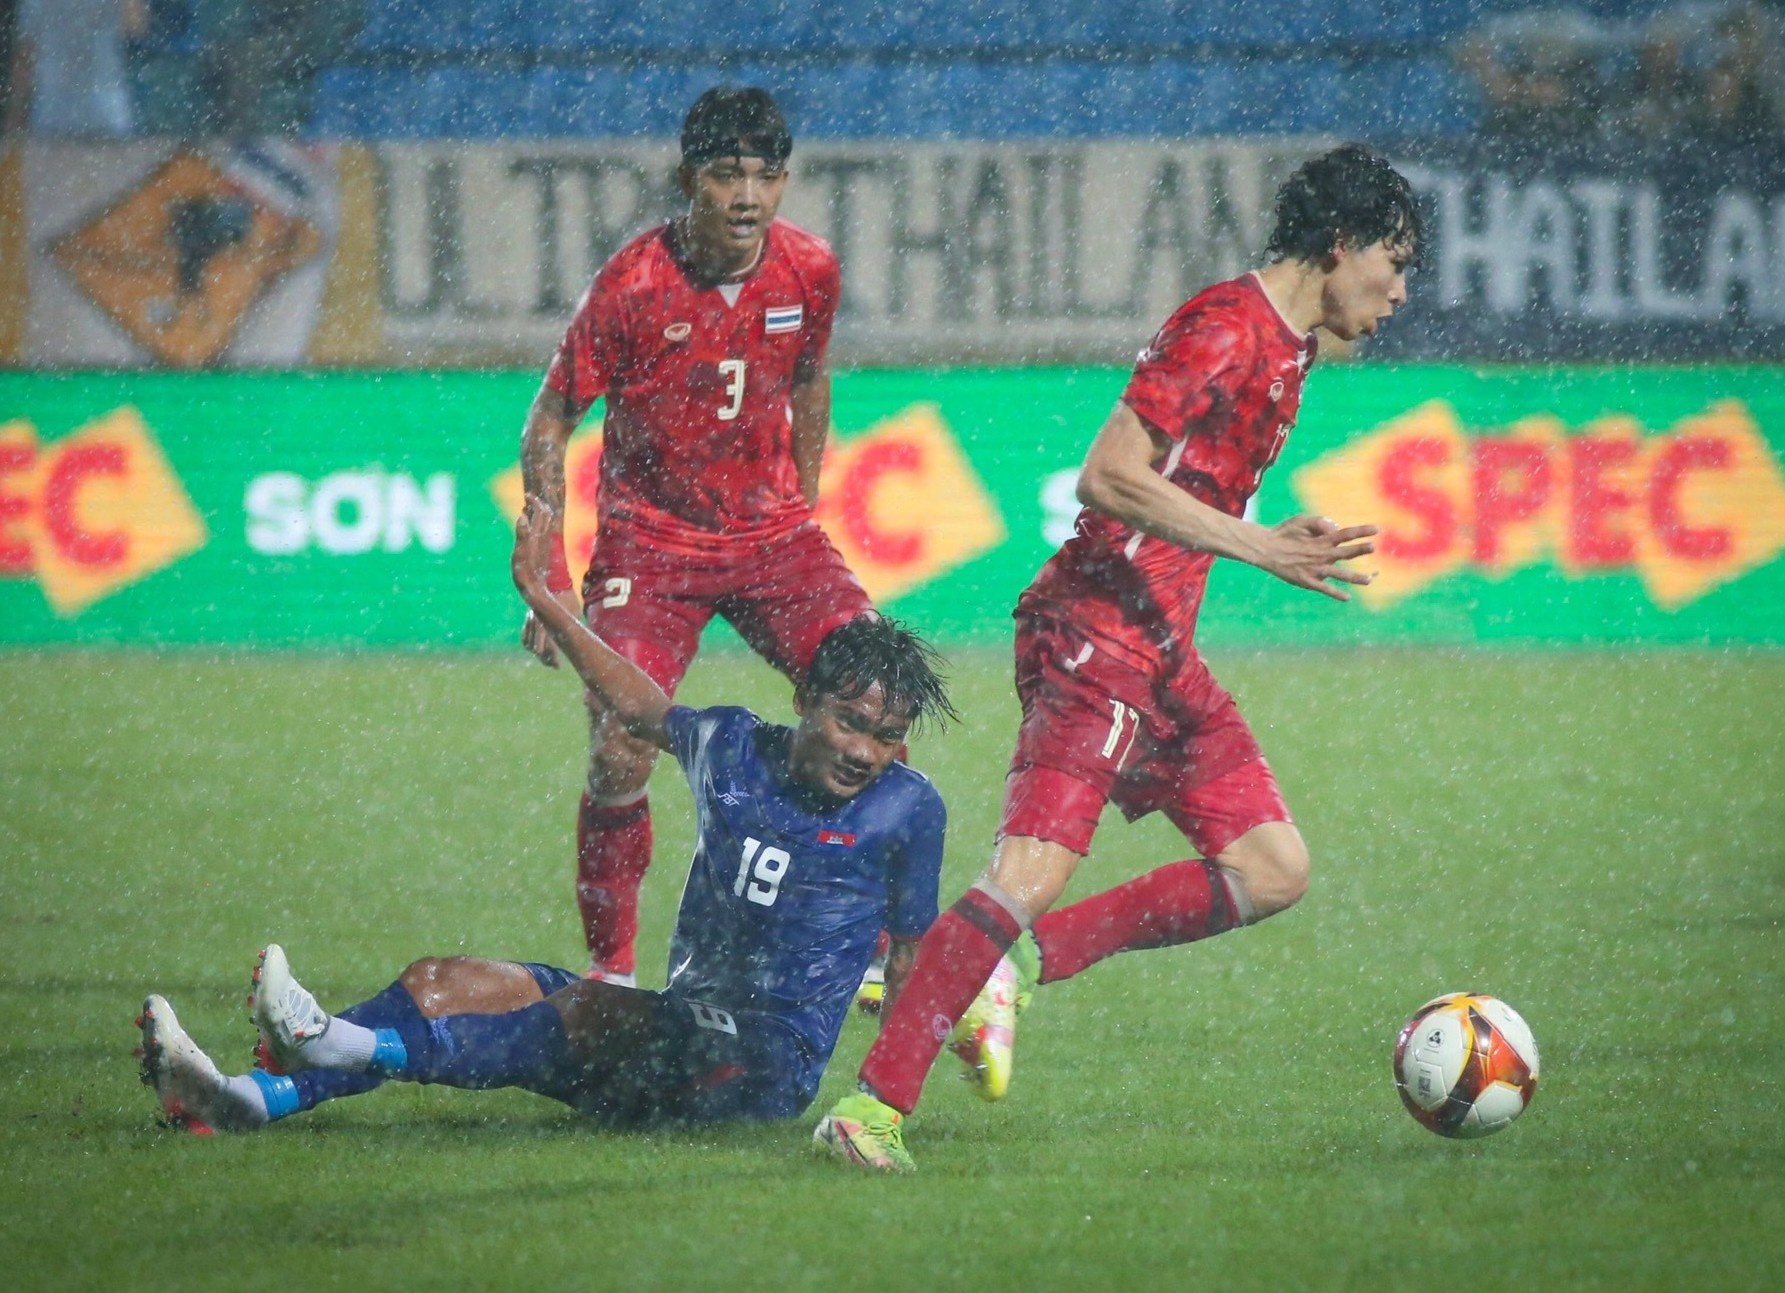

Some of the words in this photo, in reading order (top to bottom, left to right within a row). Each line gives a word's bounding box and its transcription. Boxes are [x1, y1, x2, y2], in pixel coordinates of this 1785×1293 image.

[717, 358, 745, 421] 3
[1376, 434, 1735, 566] SPEC
[733, 836, 791, 907] 19
